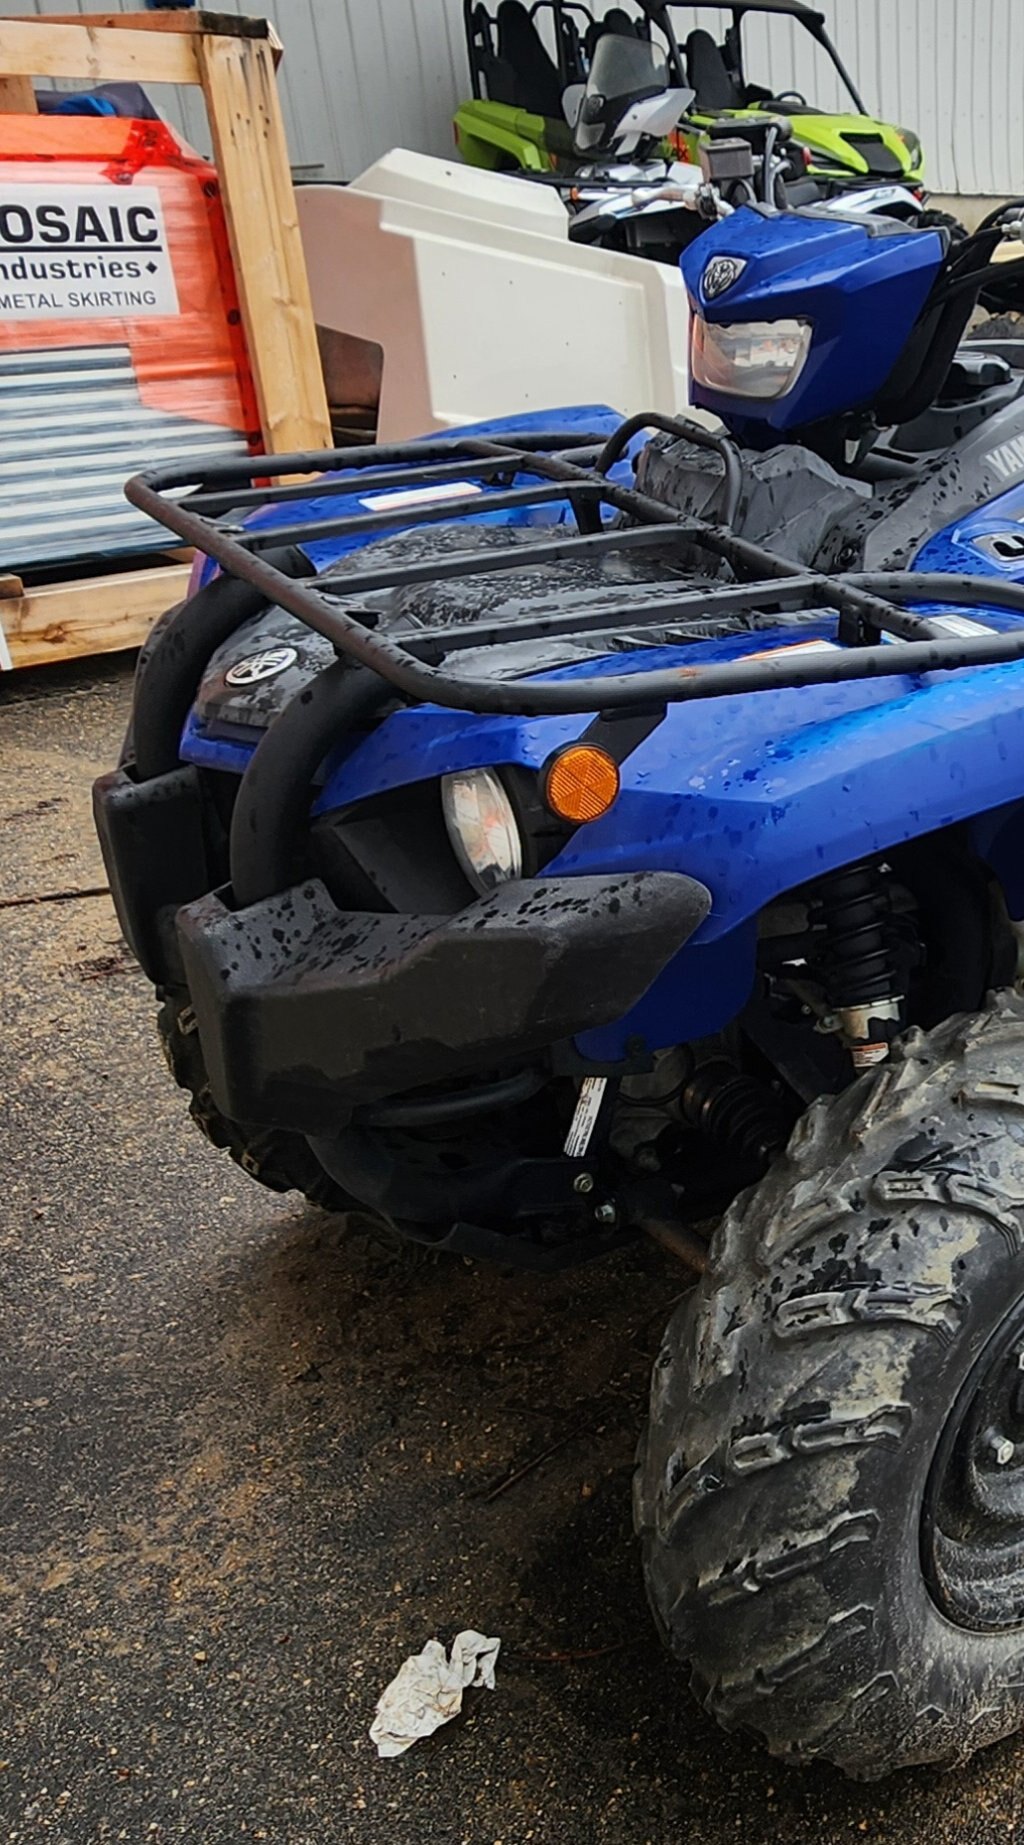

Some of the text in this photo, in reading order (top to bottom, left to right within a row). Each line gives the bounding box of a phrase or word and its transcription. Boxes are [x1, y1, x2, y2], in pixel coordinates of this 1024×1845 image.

[0, 205, 158, 243] OSAIC
[0, 290, 157, 309] METAL SKIRTING
